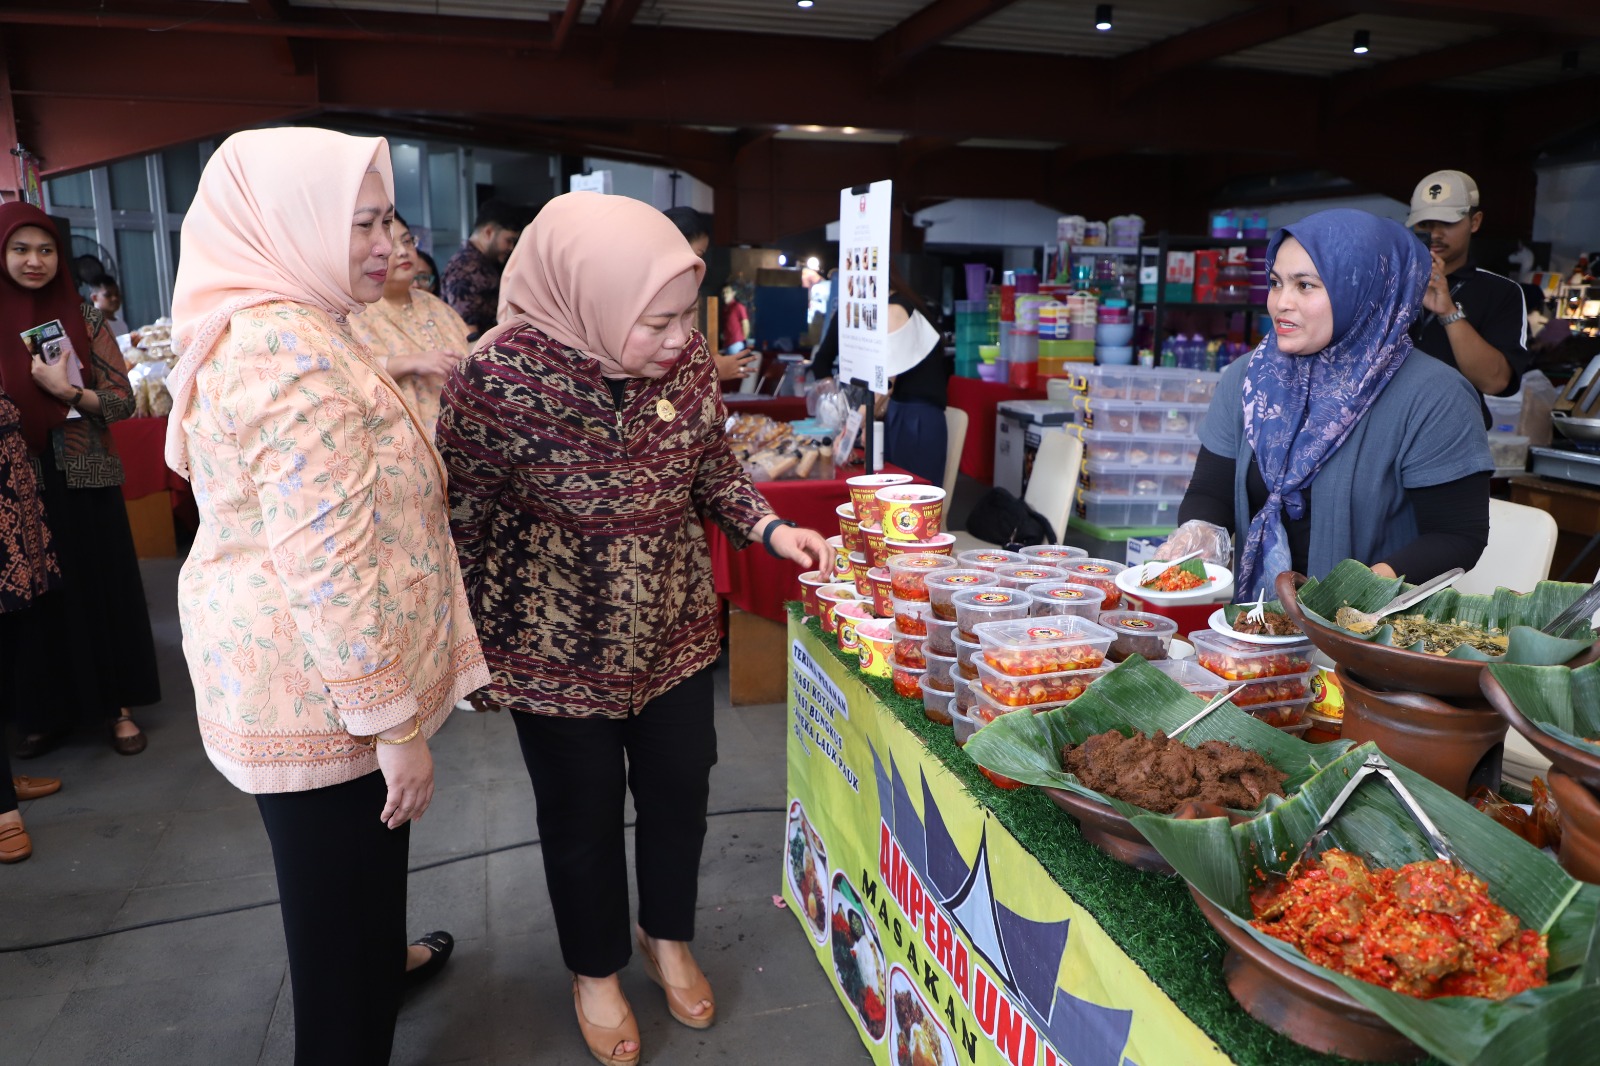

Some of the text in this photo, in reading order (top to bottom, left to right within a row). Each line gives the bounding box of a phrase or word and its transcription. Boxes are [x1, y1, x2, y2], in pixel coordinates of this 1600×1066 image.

[809, 705, 842, 750] BUNGKUS
[812, 684, 835, 720] KOTAK
[816, 732, 838, 764] LAUK
[838, 757, 859, 792] PAUK
[863, 869, 978, 1064] MASAKAN
[880, 819, 1038, 1066] AMPERA UNI
